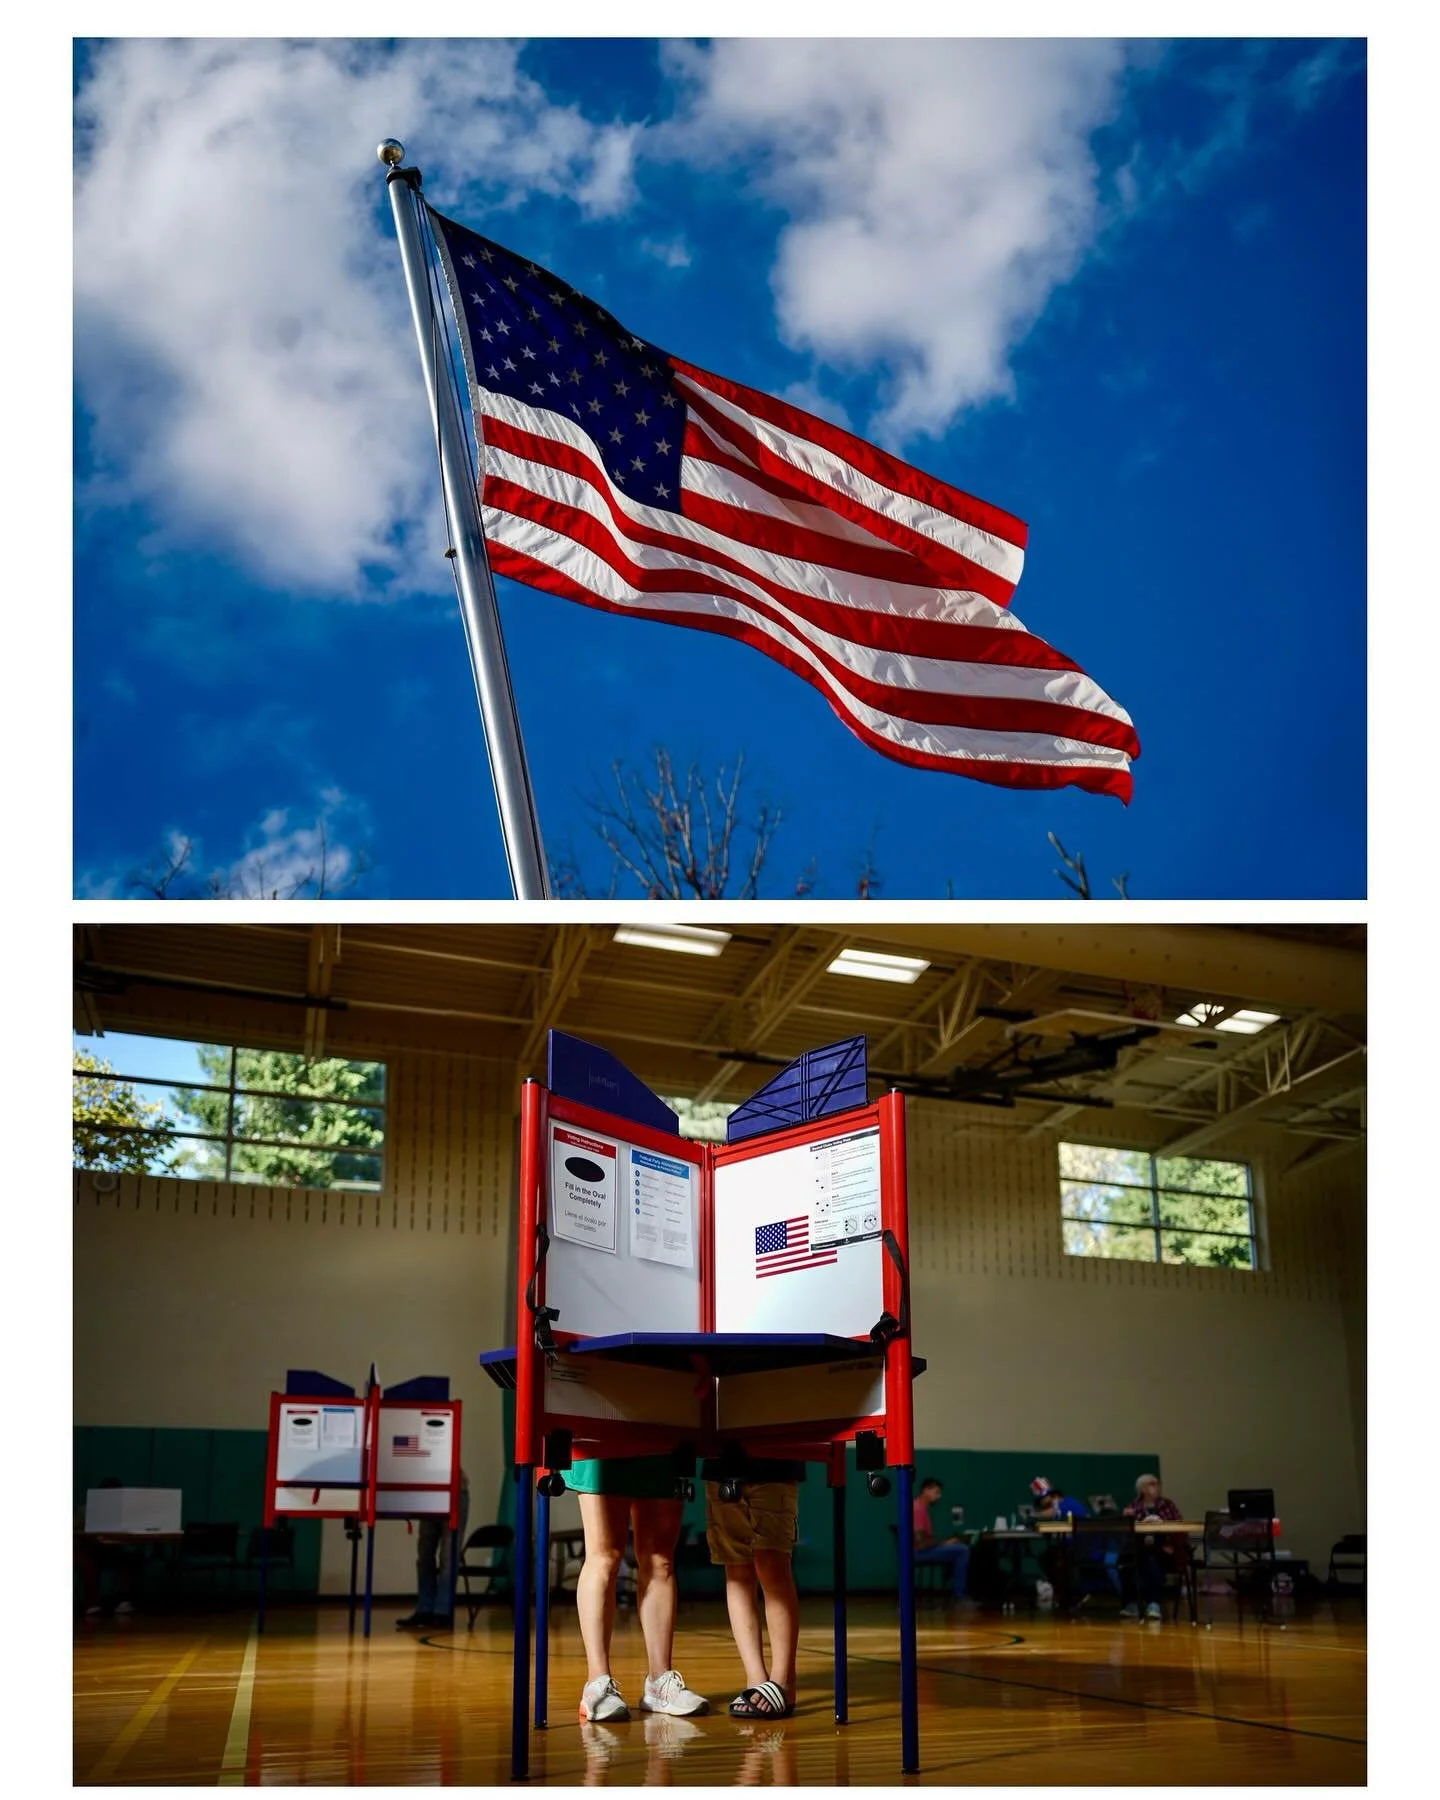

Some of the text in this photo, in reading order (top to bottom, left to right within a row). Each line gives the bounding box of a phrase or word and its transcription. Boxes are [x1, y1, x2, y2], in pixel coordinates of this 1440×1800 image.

[565, 1181, 606, 1200] Fill in the Oval
[569, 1192, 602, 1208] Completely
